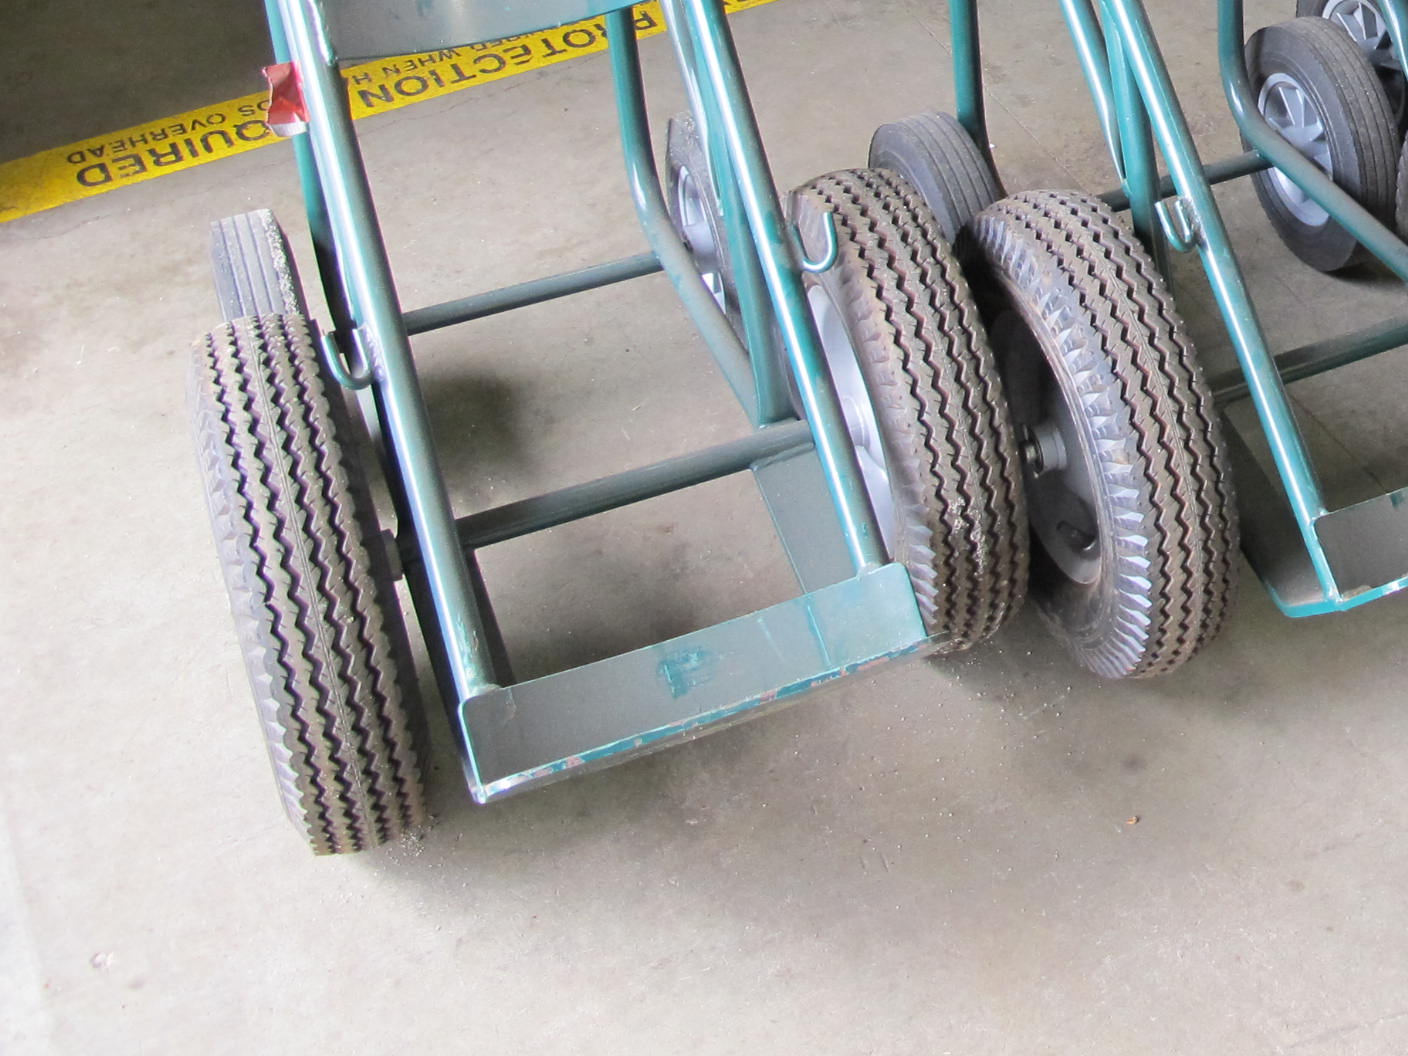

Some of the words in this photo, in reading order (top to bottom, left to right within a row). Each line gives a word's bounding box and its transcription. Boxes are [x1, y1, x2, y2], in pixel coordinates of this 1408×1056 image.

[358, 10, 657, 108] POTECTION
[382, 48, 461, 78] WHEN
[66, 113, 226, 165] OVERHEAD
[76, 120, 269, 187] QUIRED
